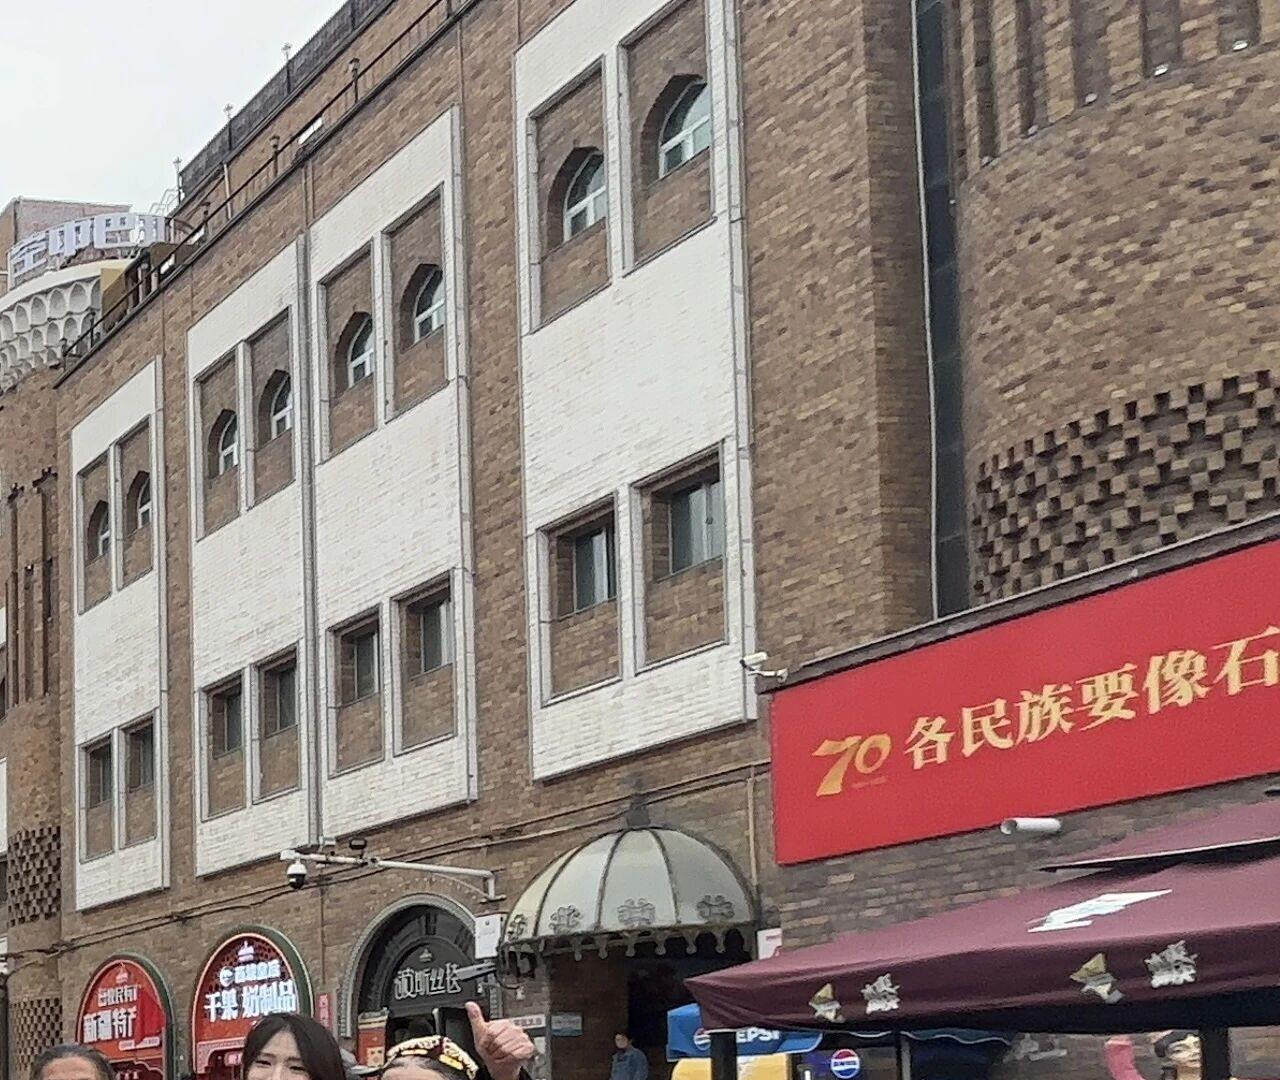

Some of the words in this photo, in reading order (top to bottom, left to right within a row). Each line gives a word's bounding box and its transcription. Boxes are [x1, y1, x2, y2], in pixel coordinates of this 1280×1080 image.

[904, 625, 1280, 771] 各民族要像石
[813, 732, 892, 797] 70
[736, 1026, 780, 1043] EPSI
